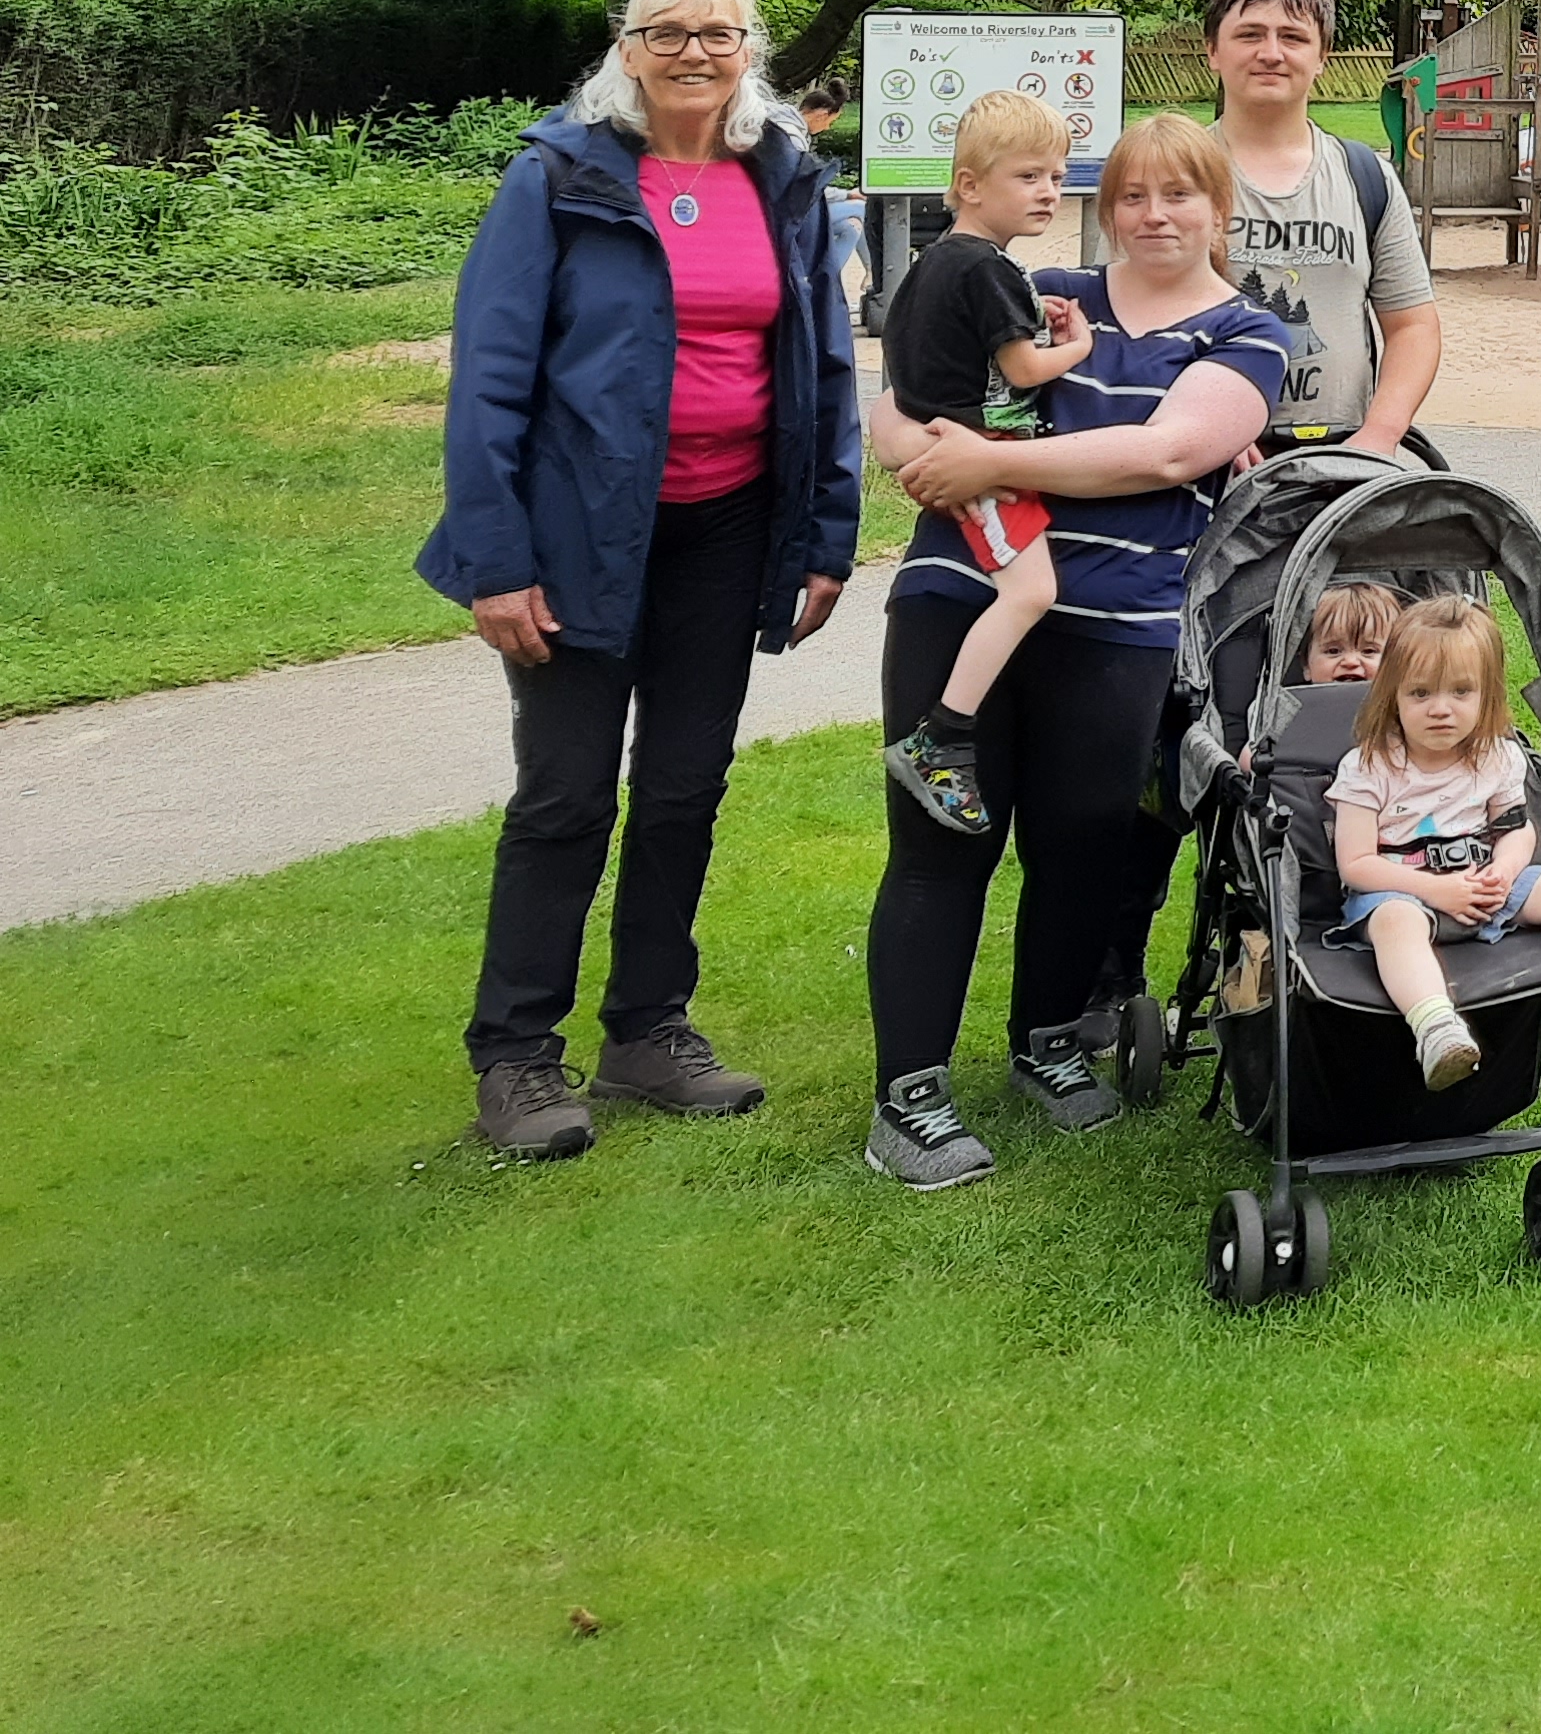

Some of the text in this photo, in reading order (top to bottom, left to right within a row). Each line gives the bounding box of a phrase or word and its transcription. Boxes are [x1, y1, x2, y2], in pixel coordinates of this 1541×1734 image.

[910, 23, 967, 35] Welcome
[971, 24, 984, 35] to
[987, 24, 1045, 38] Riversley
[1048, 25, 1077, 37] Park
[909, 48, 938, 63] Do's
[1030, 49, 1074, 65] Don'ts
